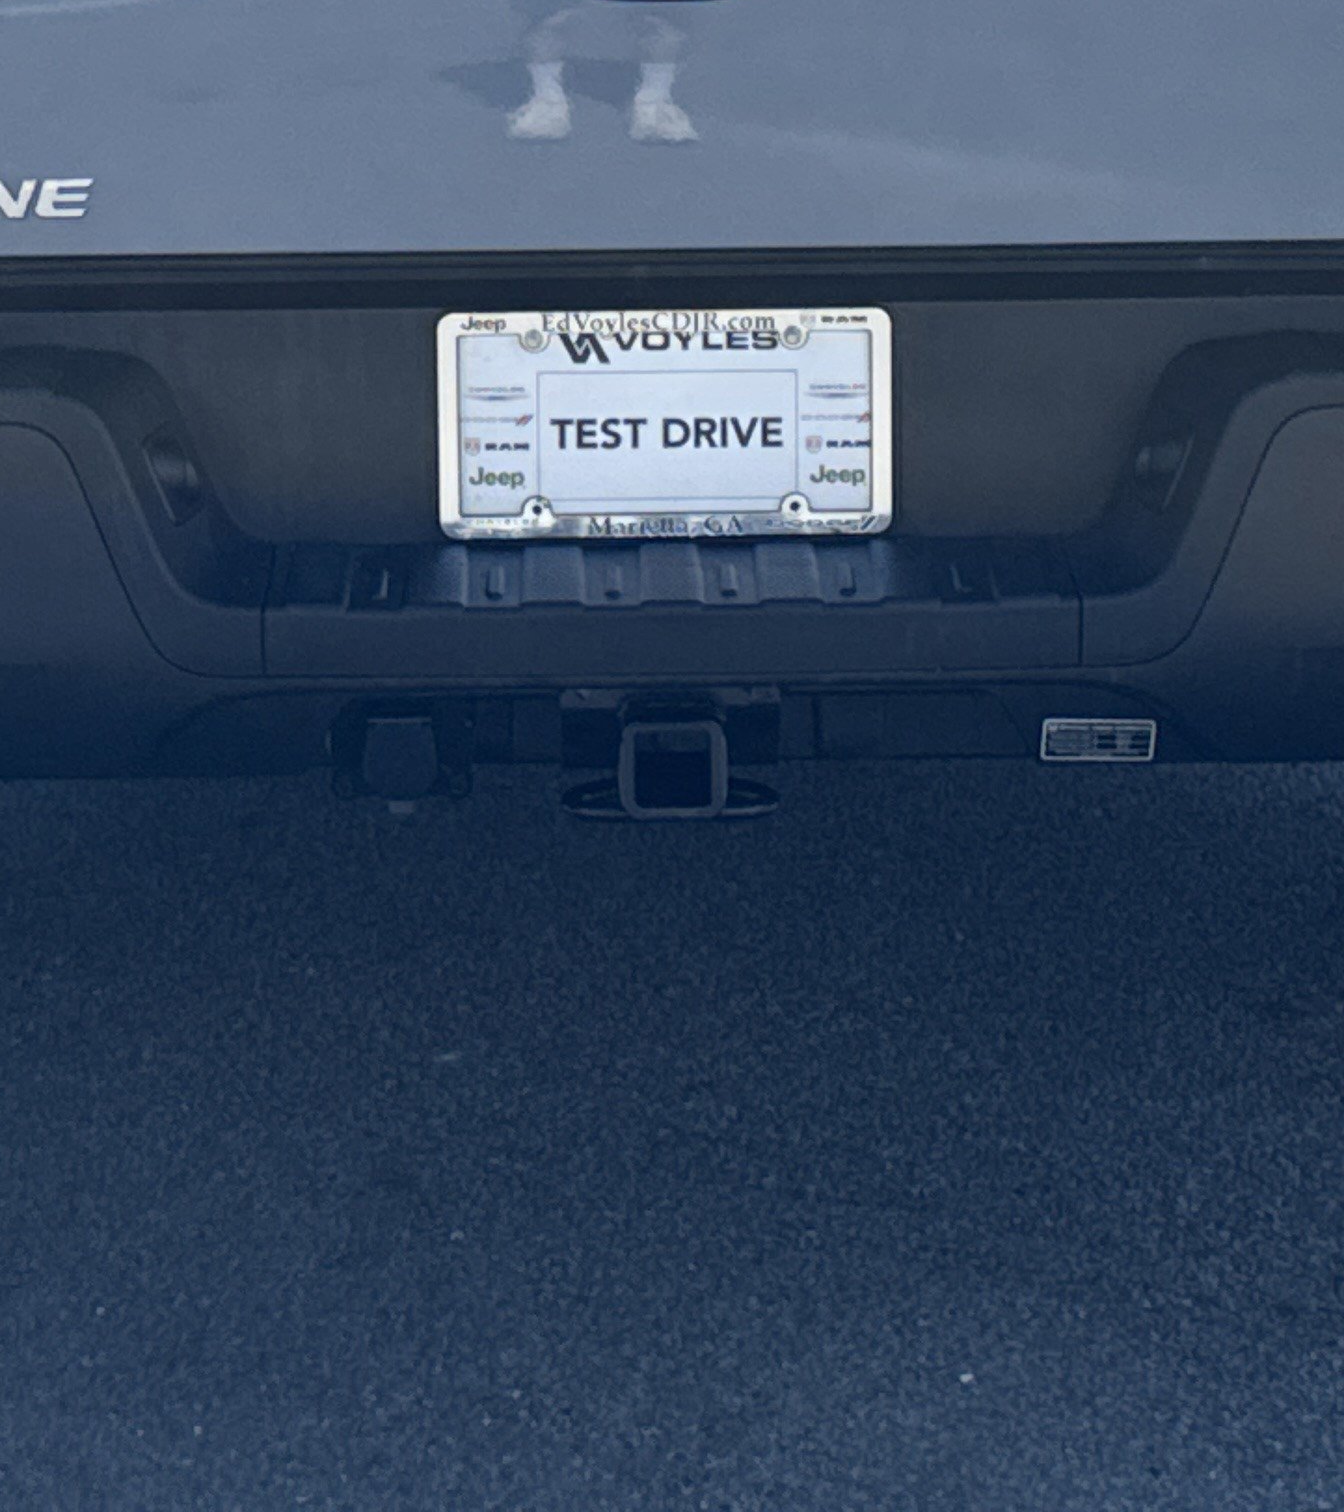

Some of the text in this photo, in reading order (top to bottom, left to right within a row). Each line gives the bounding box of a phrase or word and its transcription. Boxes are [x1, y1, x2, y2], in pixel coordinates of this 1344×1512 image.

[460, 316, 507, 333] Jeep
[542, 311, 776, 338] EdVoylesCDJR.com
[613, 331, 779, 351] VOYLES
[550, 416, 784, 450] TEST DRIVE
[469, 466, 526, 489] Jeep
[809, 463, 866, 486] Jeep
